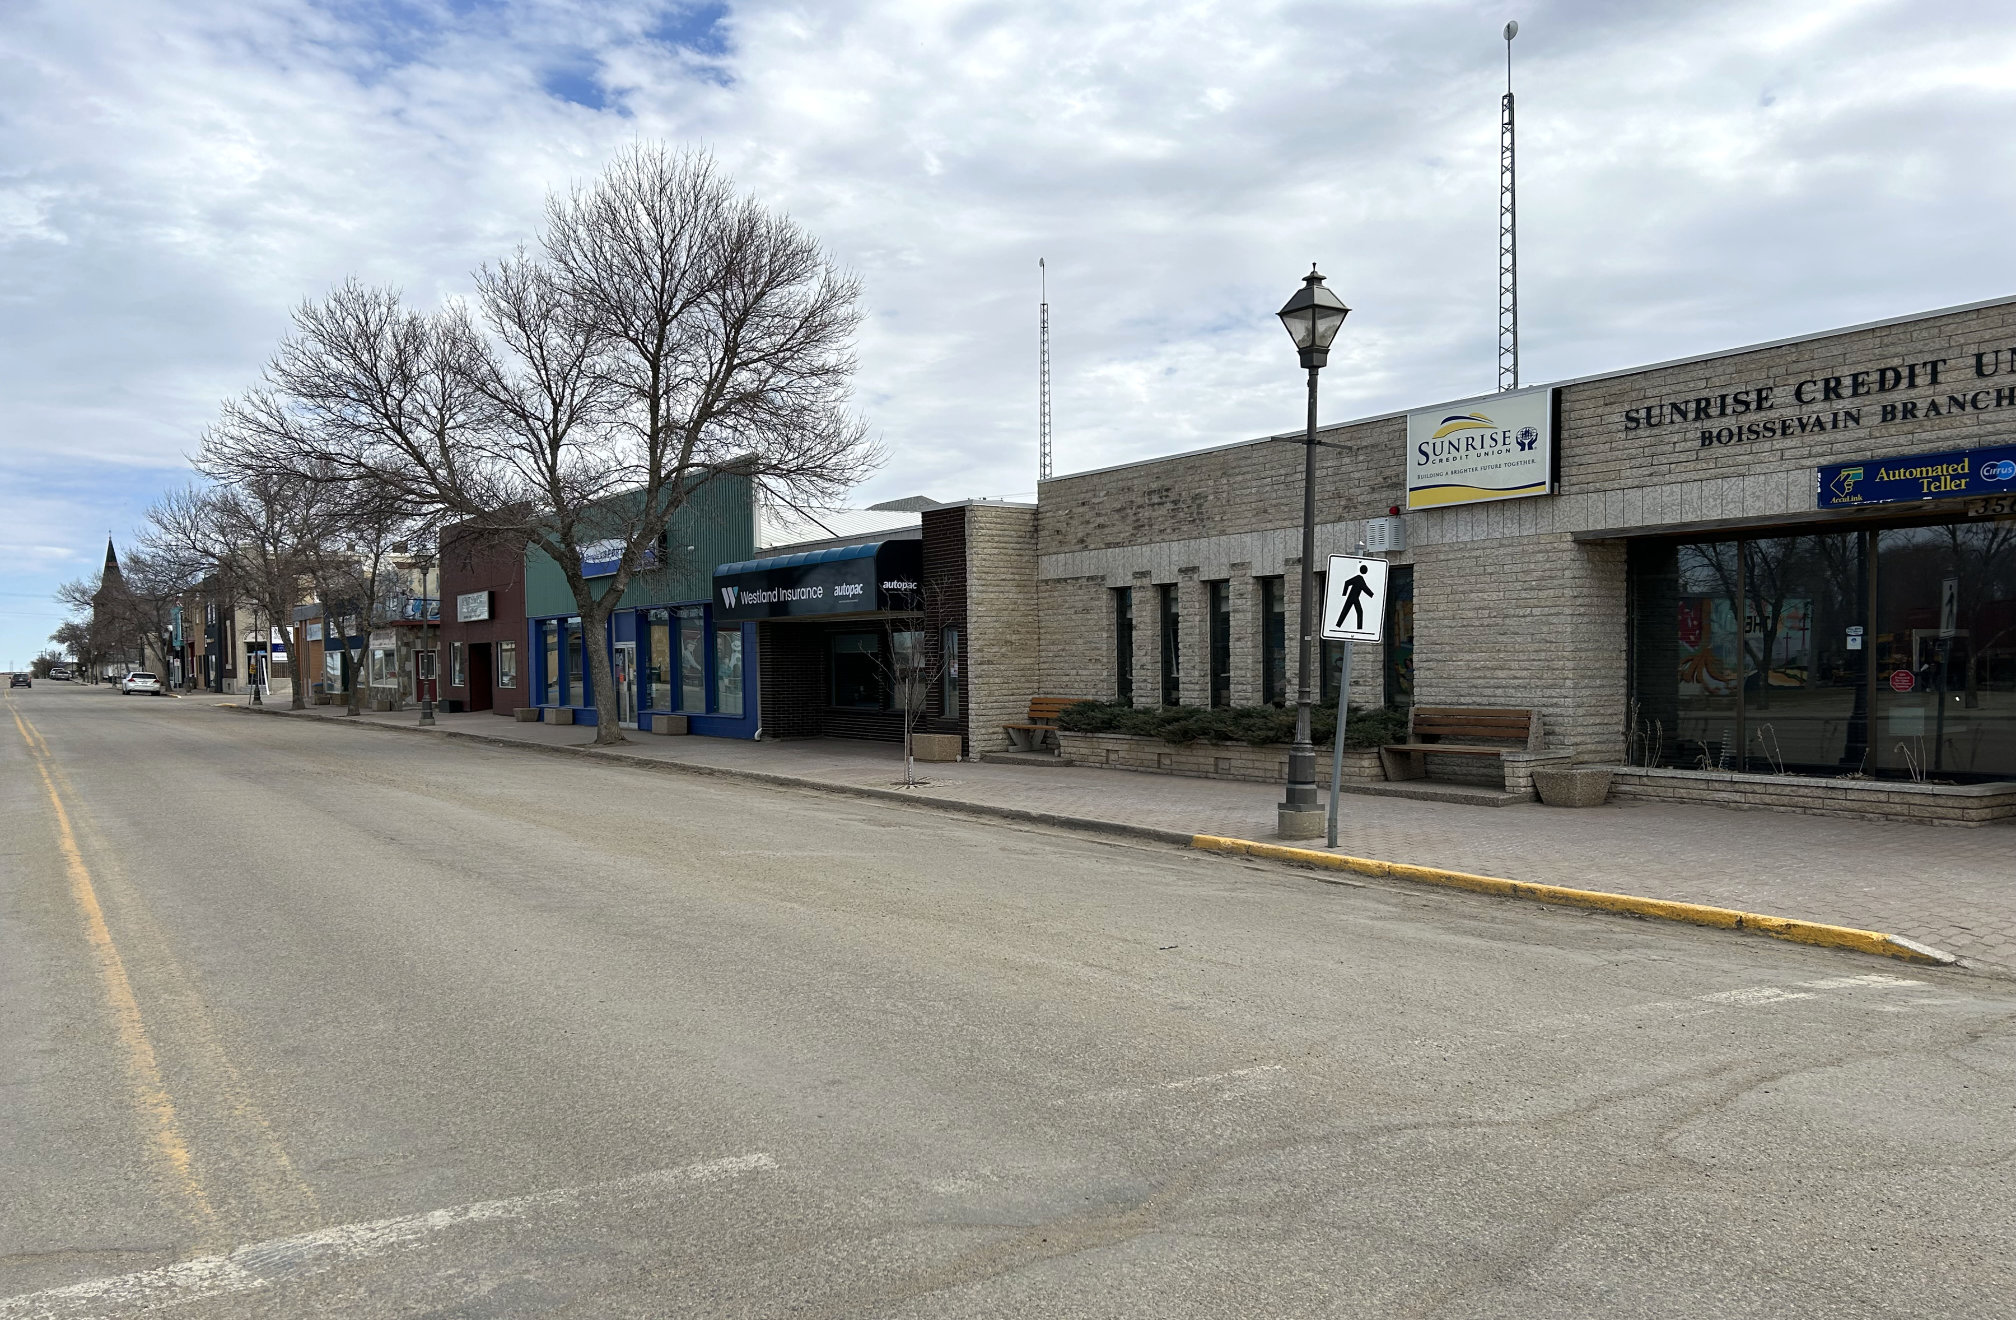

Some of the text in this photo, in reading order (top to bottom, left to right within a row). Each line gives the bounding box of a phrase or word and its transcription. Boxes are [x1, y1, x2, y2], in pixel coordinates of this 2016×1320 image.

[1624, 386, 1774, 432] SUNRISE
[1794, 359, 1947, 404] CREDIT
[1699, 386, 2016, 447] BOISSEVAIN BRANCH
[1417, 430, 1511, 466] SUNRISE
[1431, 448, 1511, 465] CREDIT UNION
[1417, 471, 1444, 480] BUILDING
[1450, 466, 1479, 475] BRIGHTER
[1480, 463, 1502, 472] FUTURE
[1875, 458, 1970, 482] Automated
[1983, 466, 2013, 476] Cirrus
[1919, 477, 1970, 493] Teller
[834, 582, 863, 597] autopac
[882, 579, 917, 591] autopac
[740, 585, 823, 605] Westland Insurance
